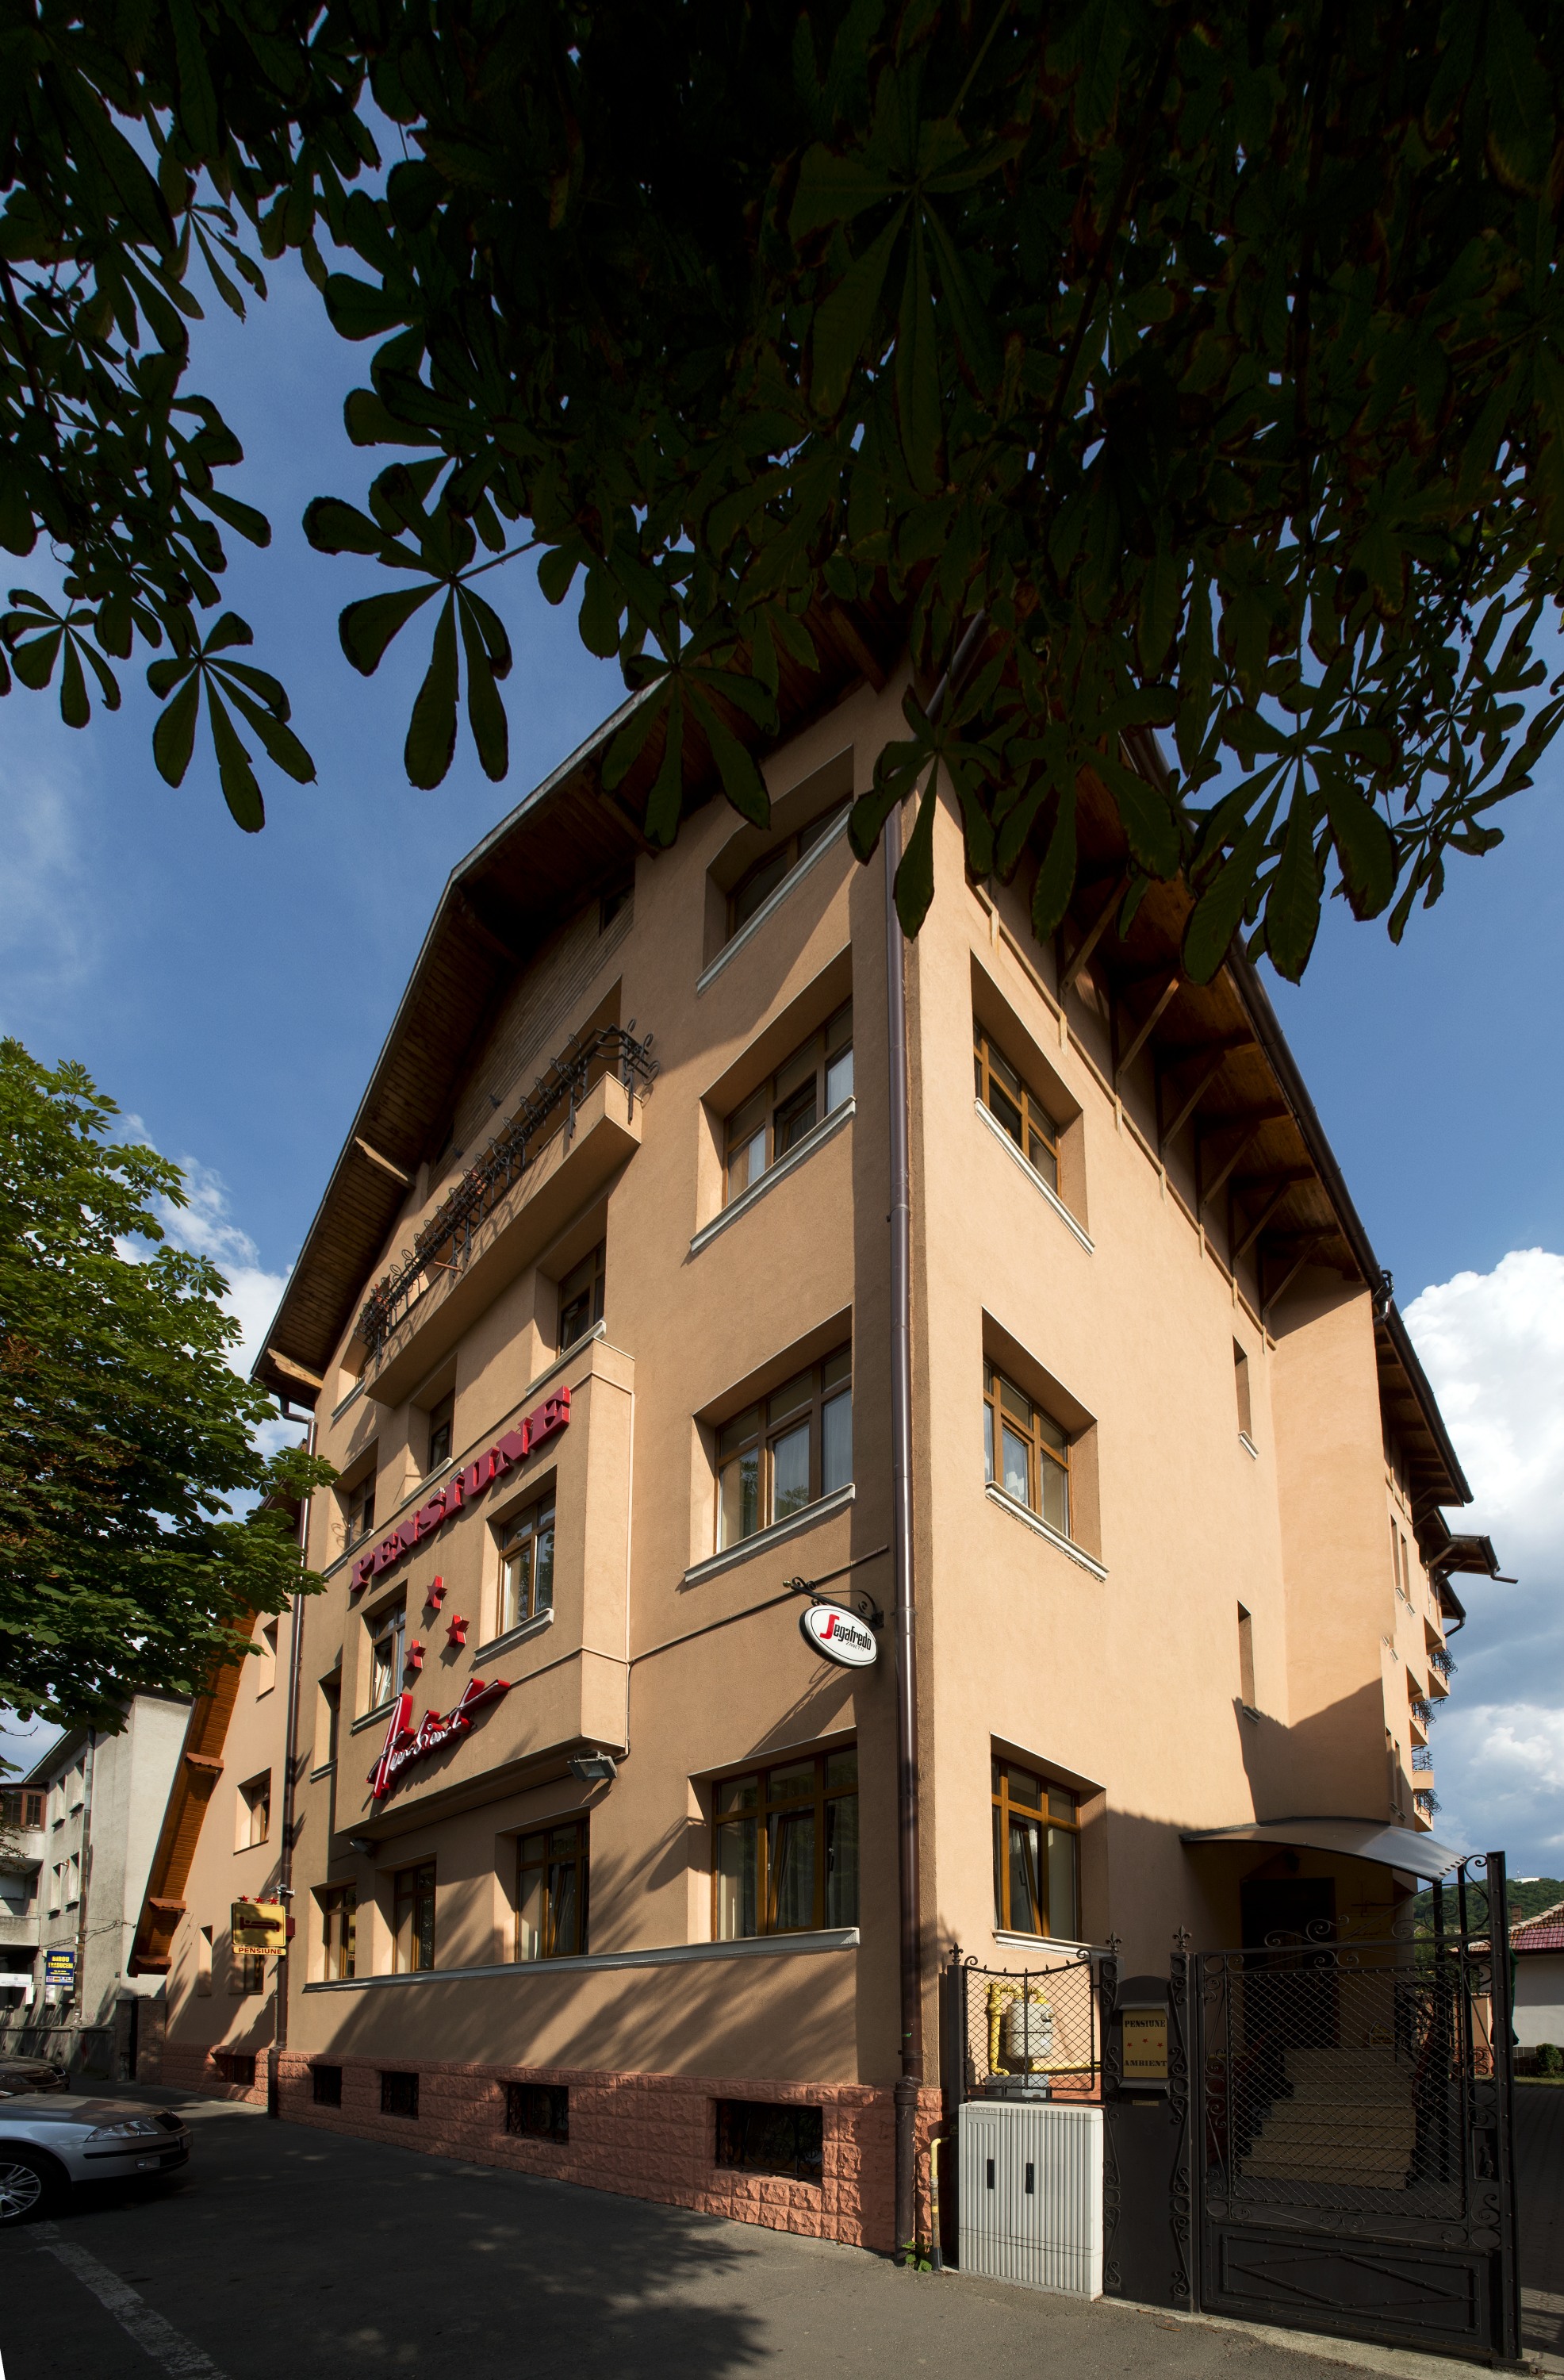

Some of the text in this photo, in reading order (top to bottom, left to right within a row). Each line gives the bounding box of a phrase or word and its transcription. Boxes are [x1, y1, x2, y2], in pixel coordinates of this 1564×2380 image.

[350, 1385, 571, 1593] PENSIUNE
[819, 1614, 872, 1651] Segafredo
[845, 1641, 864, 1652] ZANETTI
